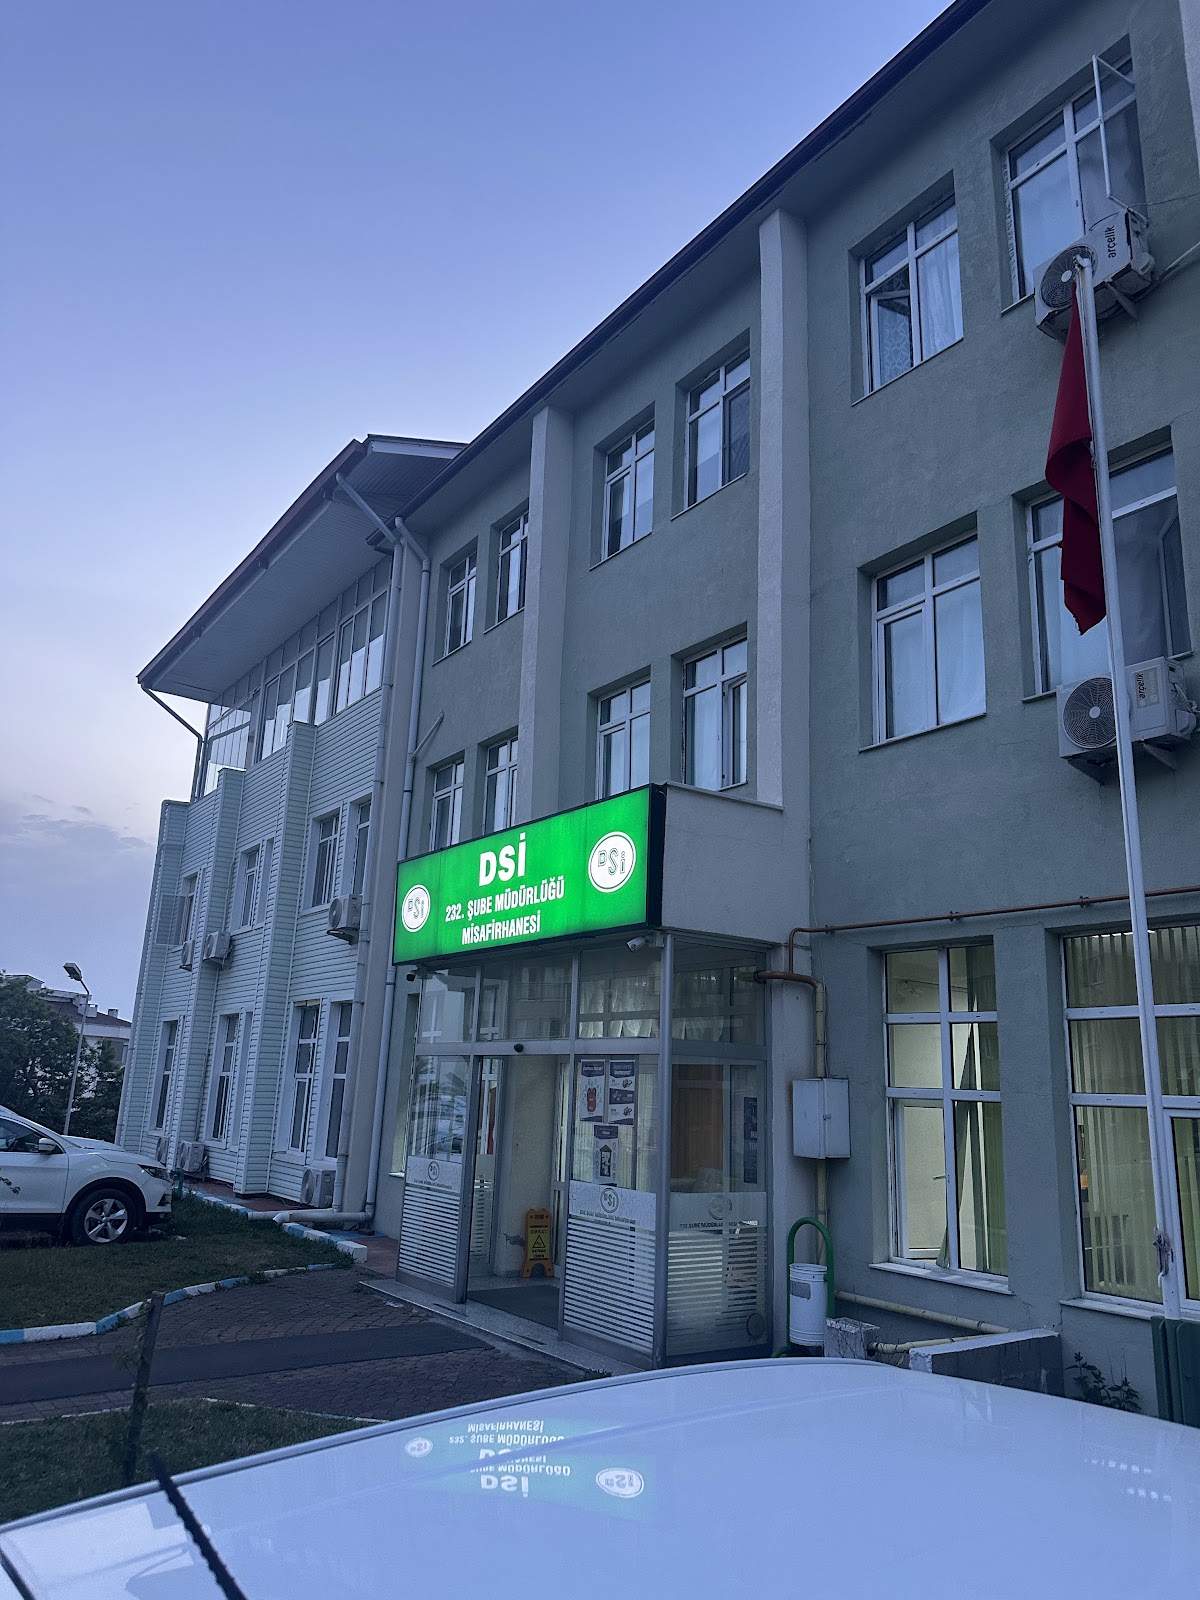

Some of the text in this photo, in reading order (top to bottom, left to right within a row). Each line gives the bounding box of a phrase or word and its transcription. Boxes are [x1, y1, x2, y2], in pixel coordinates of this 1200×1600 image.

[1104, 225, 1116, 258] arçelik
[1137, 673, 1145, 698] arçelik
[478, 832, 526, 886] DSİ
[445, 875, 565, 922] 232. ŞUBE MÜDÜRLÜĞÜ
[462, 910, 541, 945] MİSAFİRHANESİ
